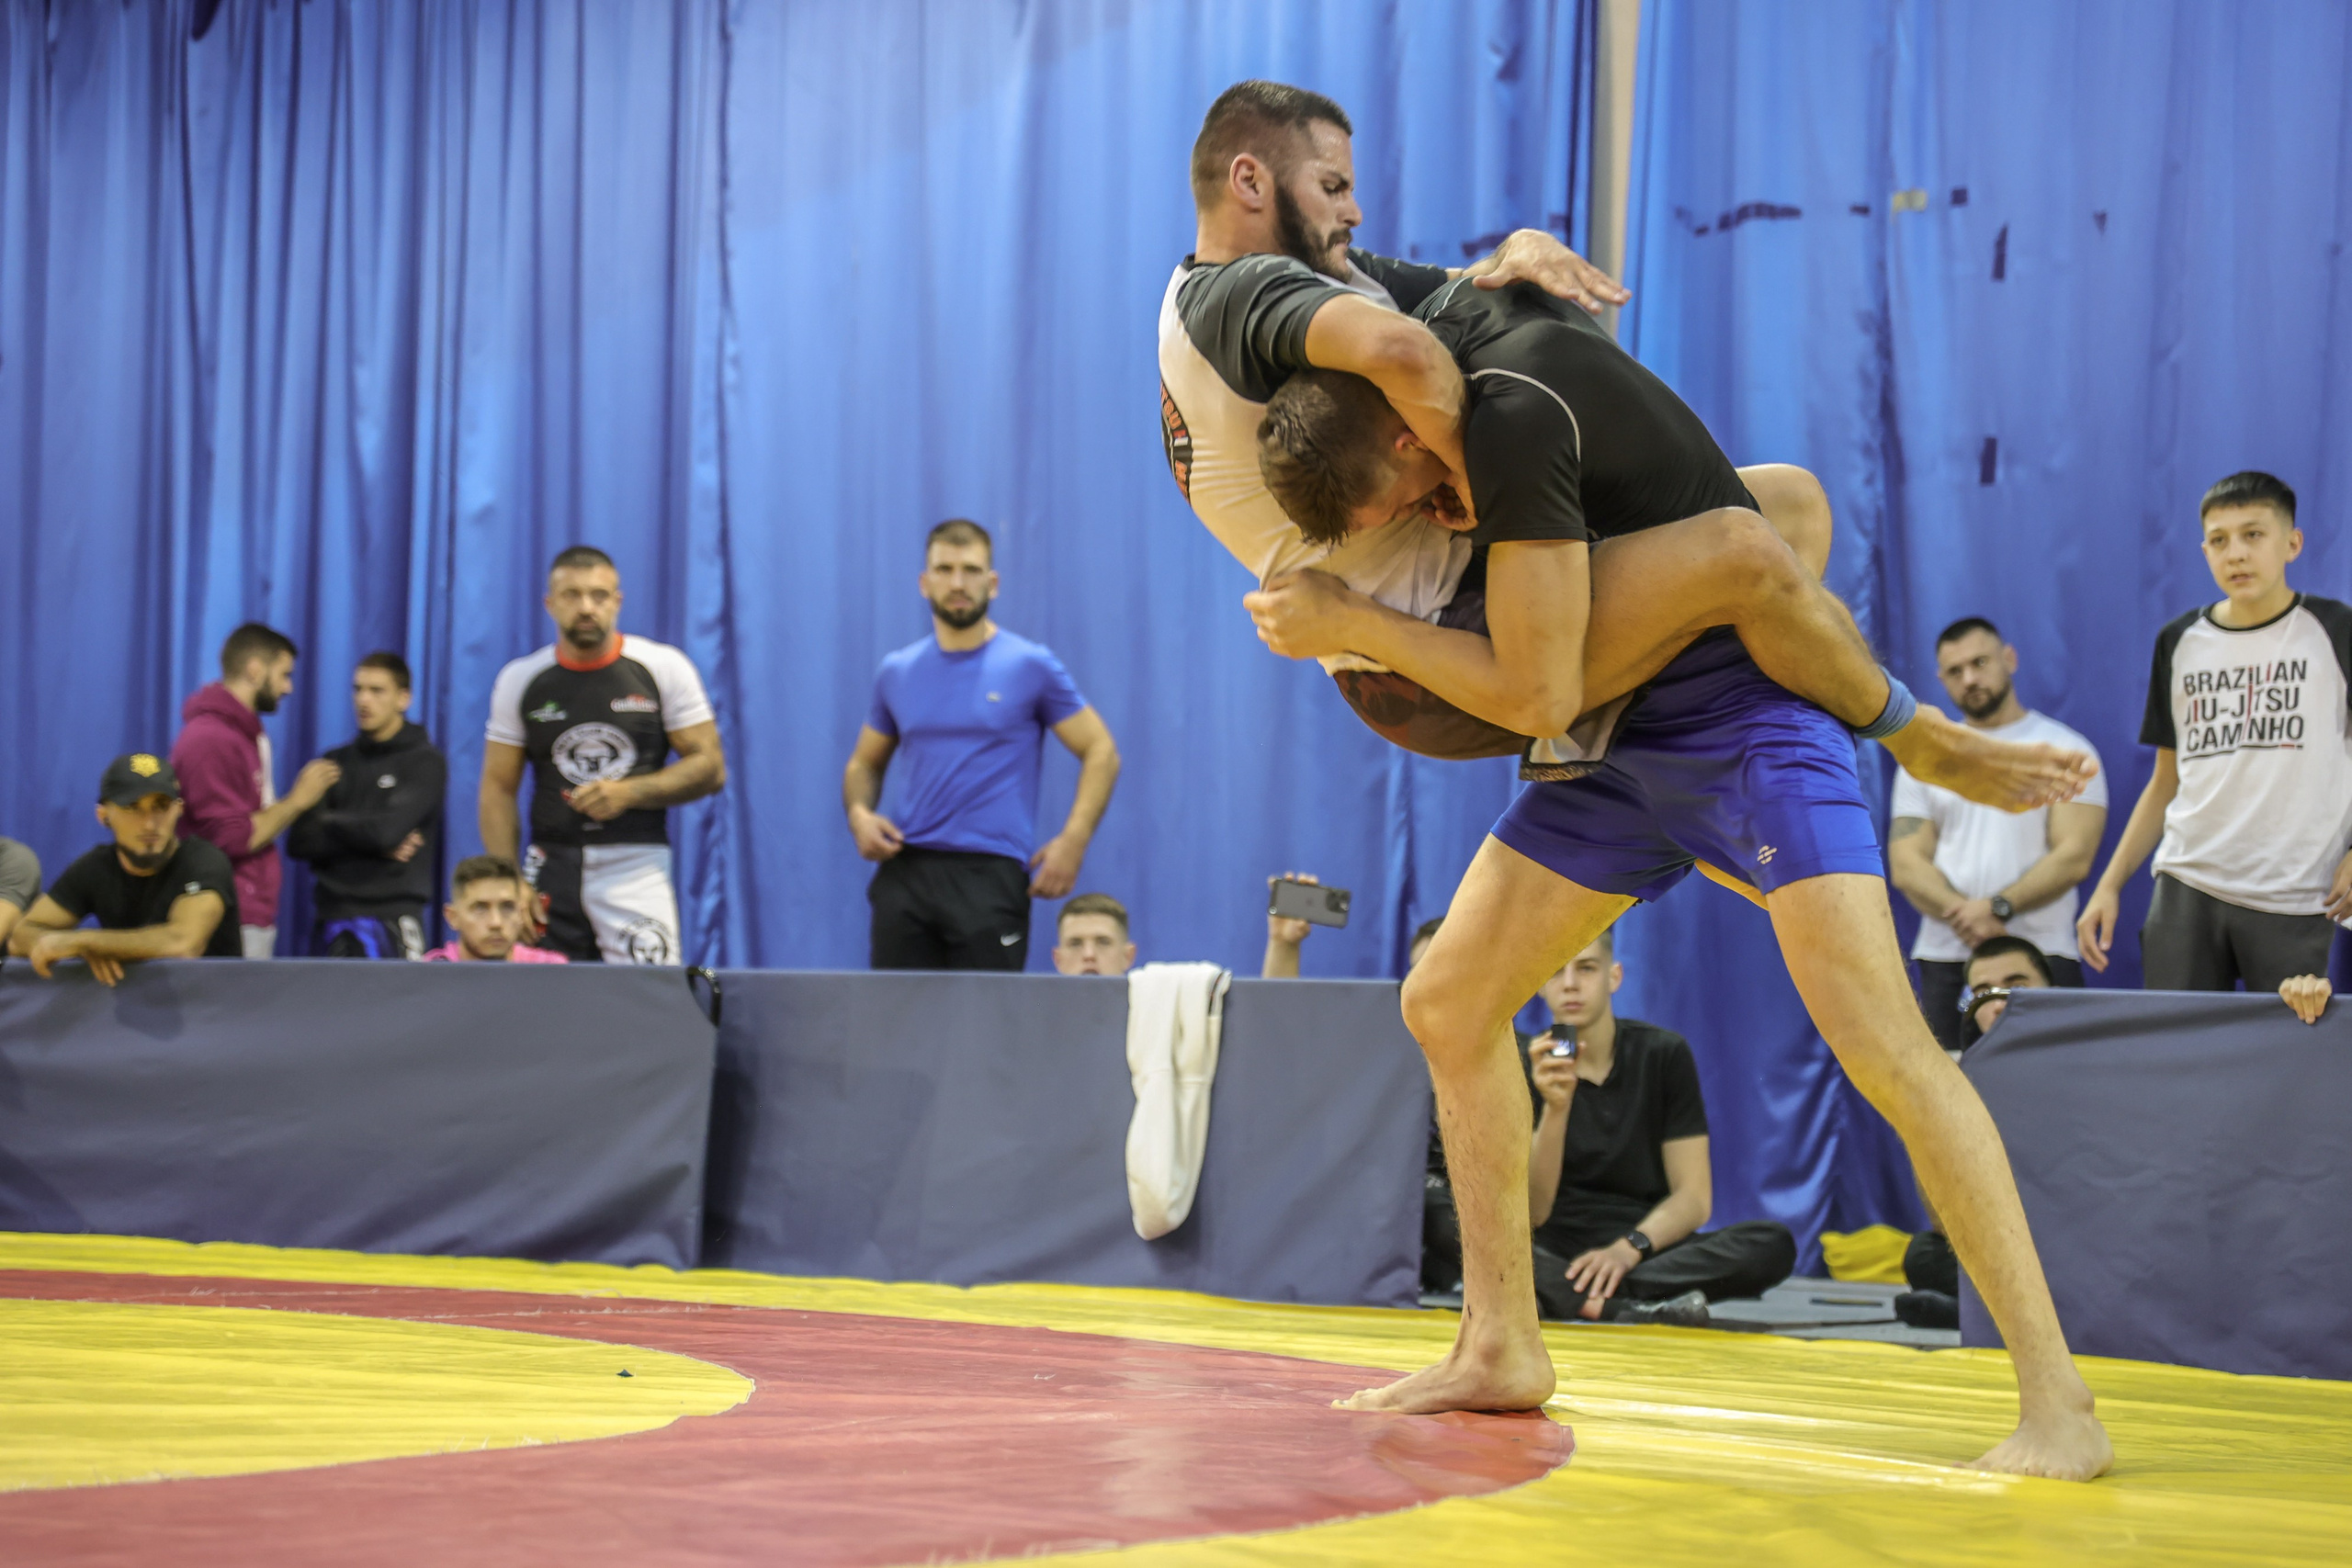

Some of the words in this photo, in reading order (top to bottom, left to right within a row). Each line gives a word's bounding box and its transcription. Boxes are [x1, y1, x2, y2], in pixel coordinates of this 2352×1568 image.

[2183, 659, 2307, 697] BRAZILIAN
[2184, 686, 2300, 726] JIU-JITSU
[2188, 716, 2304, 752] CAMINHO
